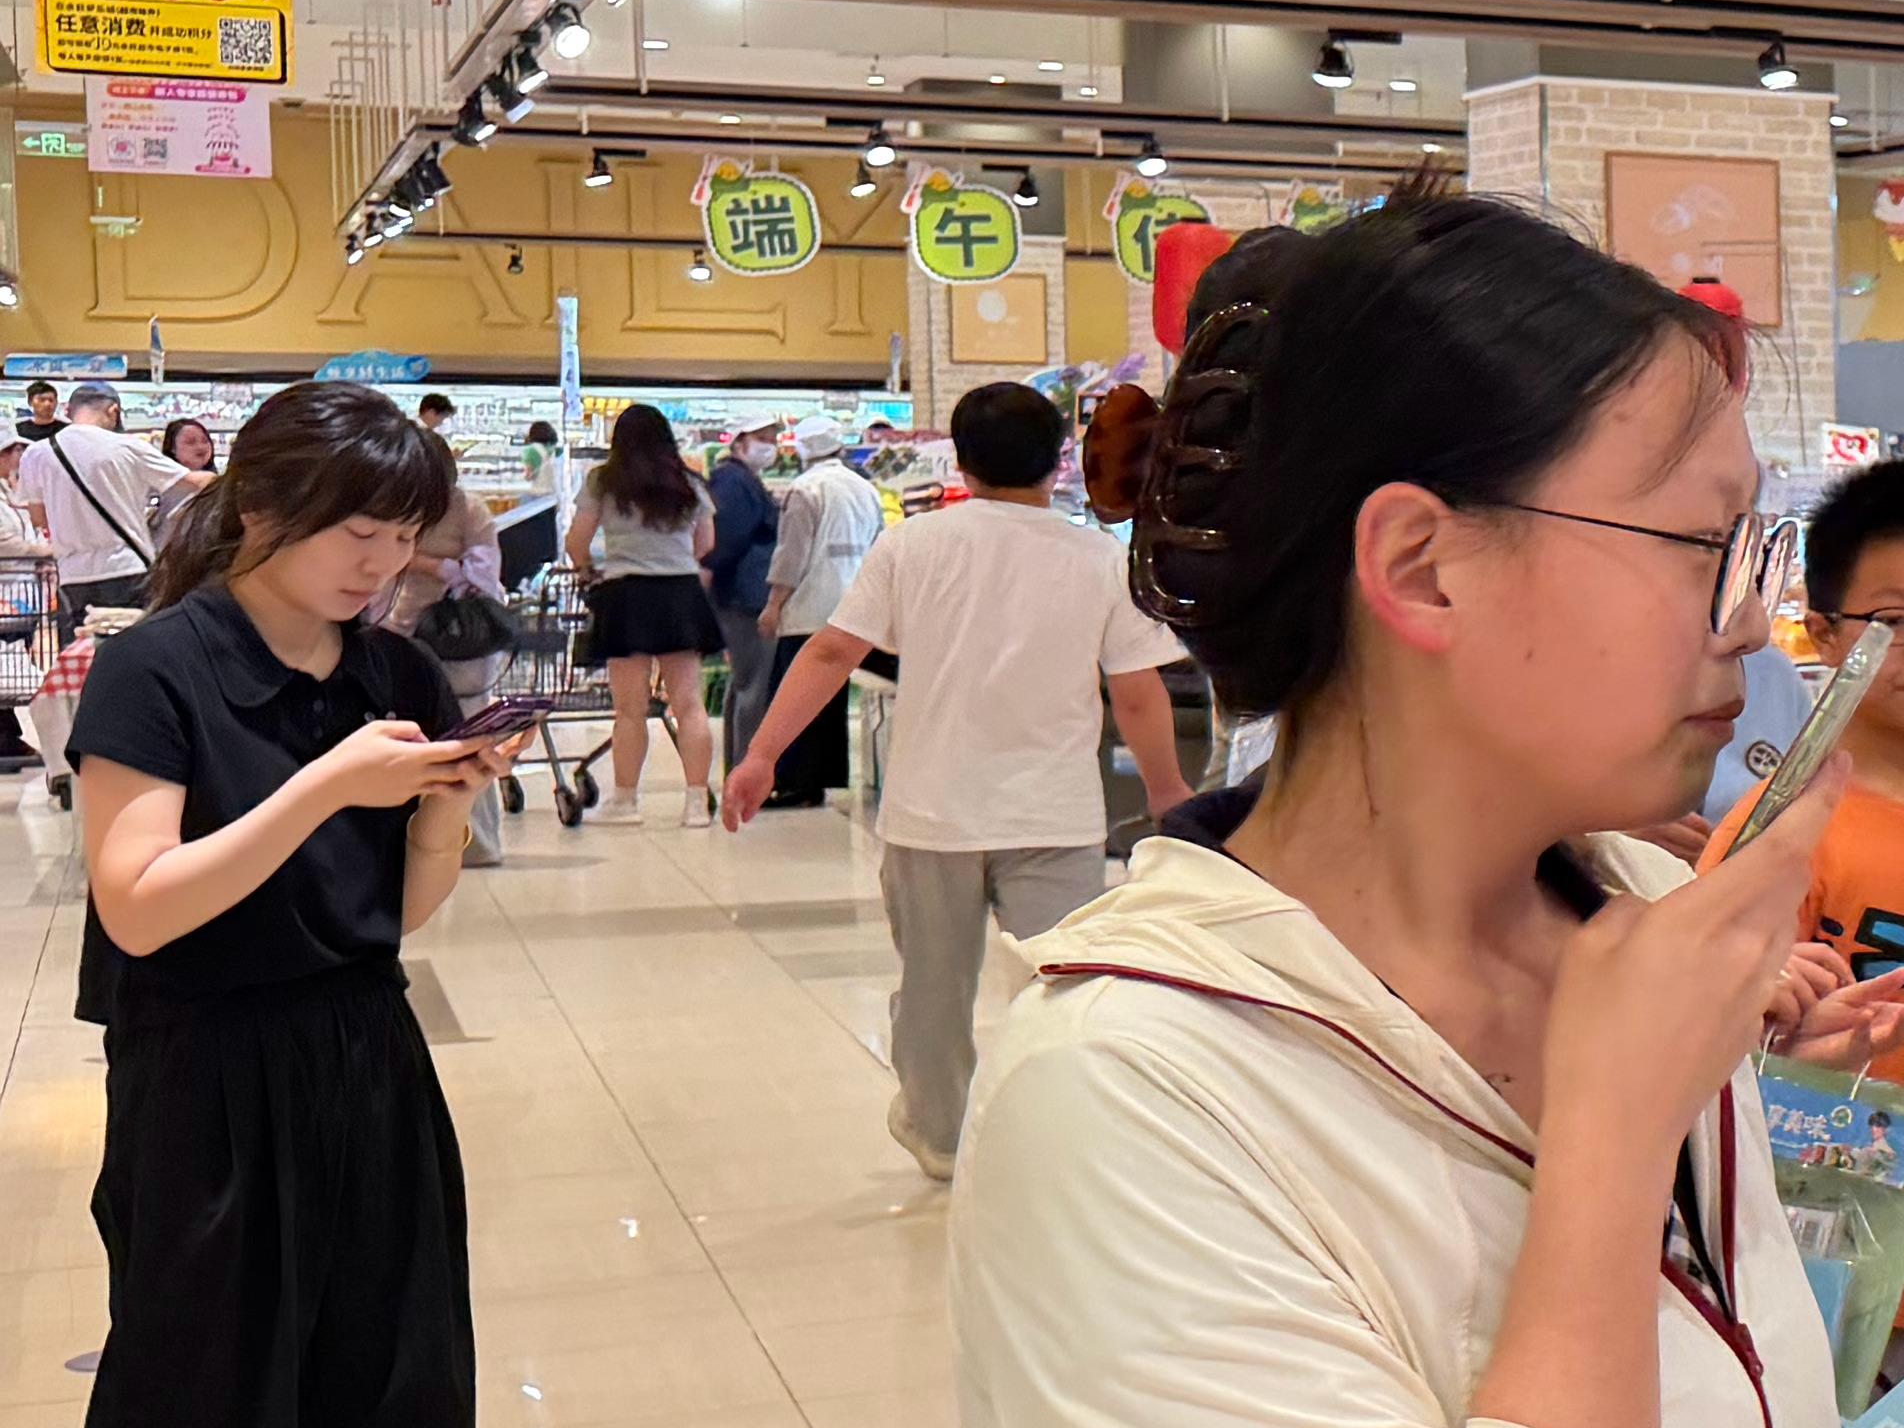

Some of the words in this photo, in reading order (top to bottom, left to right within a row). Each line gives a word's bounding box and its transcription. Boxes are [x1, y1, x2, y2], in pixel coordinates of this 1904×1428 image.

[55, 15, 147, 38] 任意消费
[727, 194, 798, 260] 端
[933, 208, 999, 269] 午
